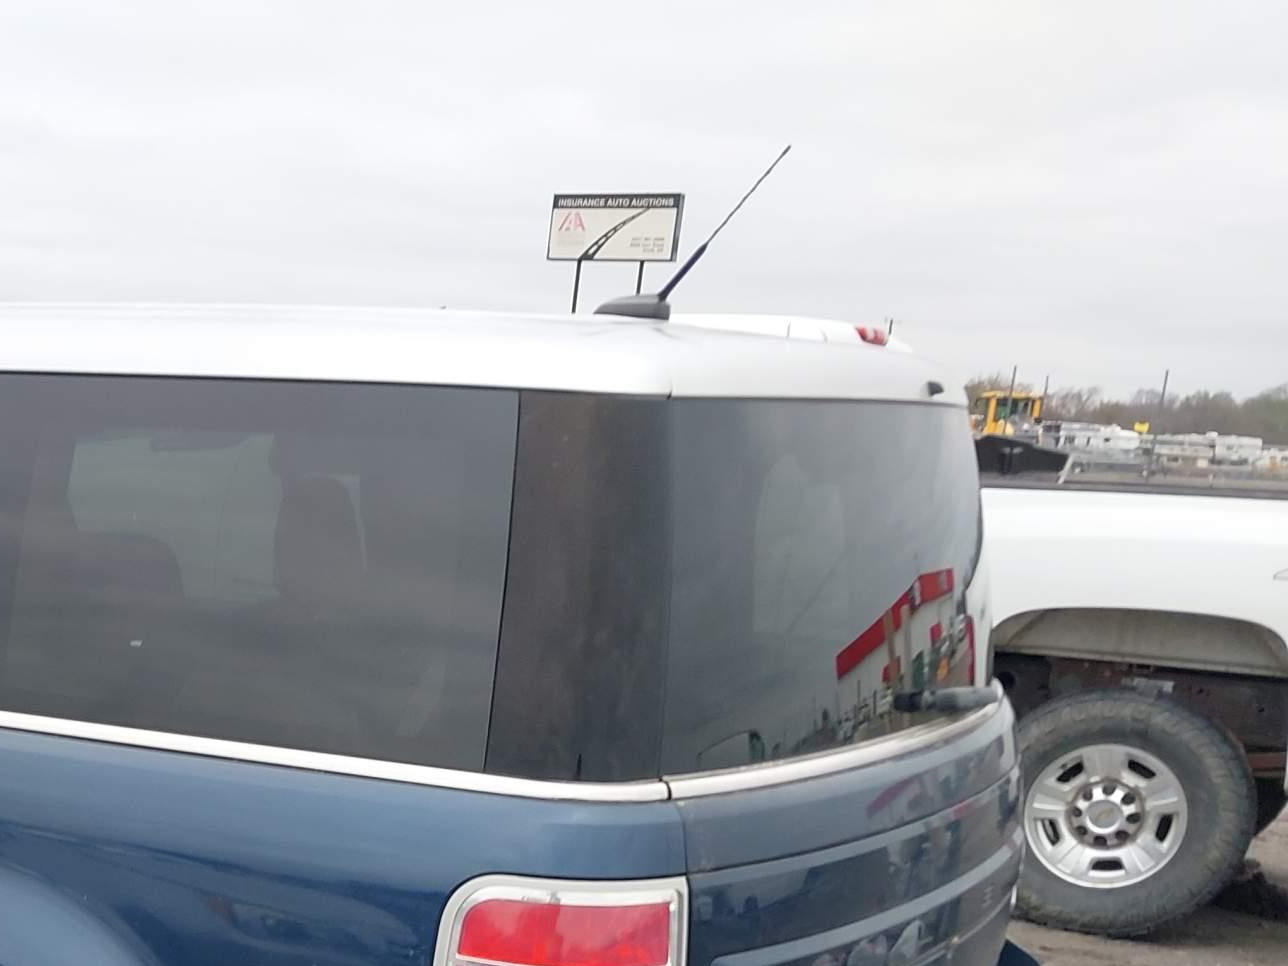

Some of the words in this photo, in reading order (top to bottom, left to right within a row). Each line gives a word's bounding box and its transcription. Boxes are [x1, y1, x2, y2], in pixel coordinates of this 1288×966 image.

[557, 197, 605, 207] INSURANCE
[606, 197, 630, 207] AUTO
[631, 197, 674, 207] AUCTIONS
